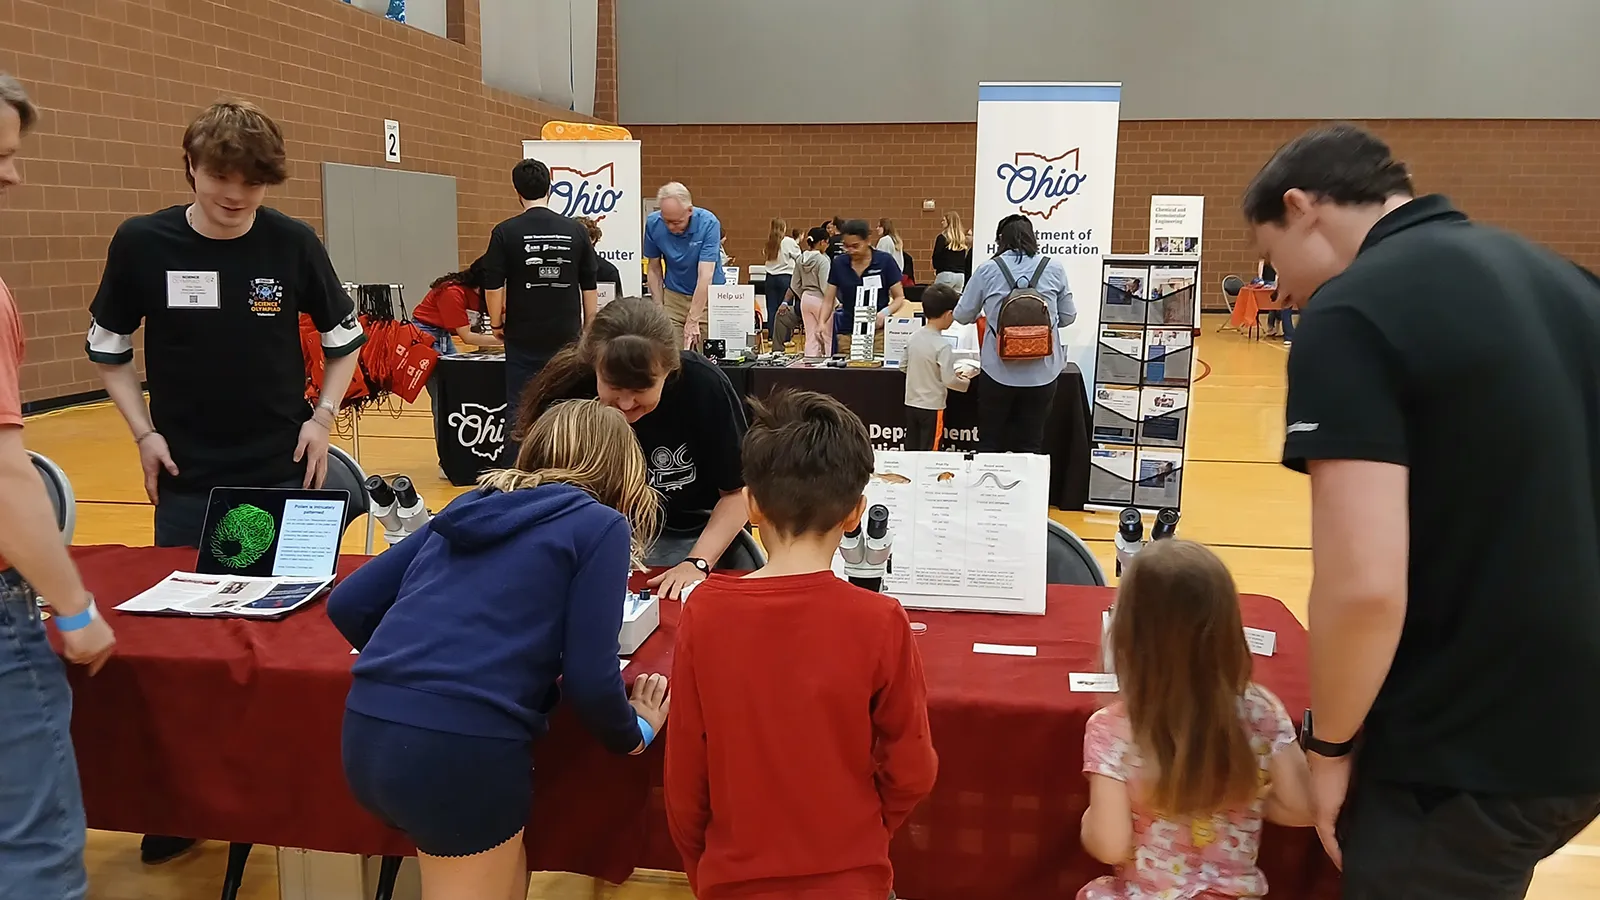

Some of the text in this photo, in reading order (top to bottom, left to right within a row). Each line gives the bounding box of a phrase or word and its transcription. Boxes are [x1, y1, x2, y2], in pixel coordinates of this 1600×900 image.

[389, 133, 397, 156] 2
[997, 164, 1087, 204] Ohio
[548, 180, 623, 217] Ohio
[1035, 228, 1092, 240] tment of
[599, 249, 635, 261] puter
[717, 292, 745, 301] Help us!
[448, 412, 506, 447] Ohi
